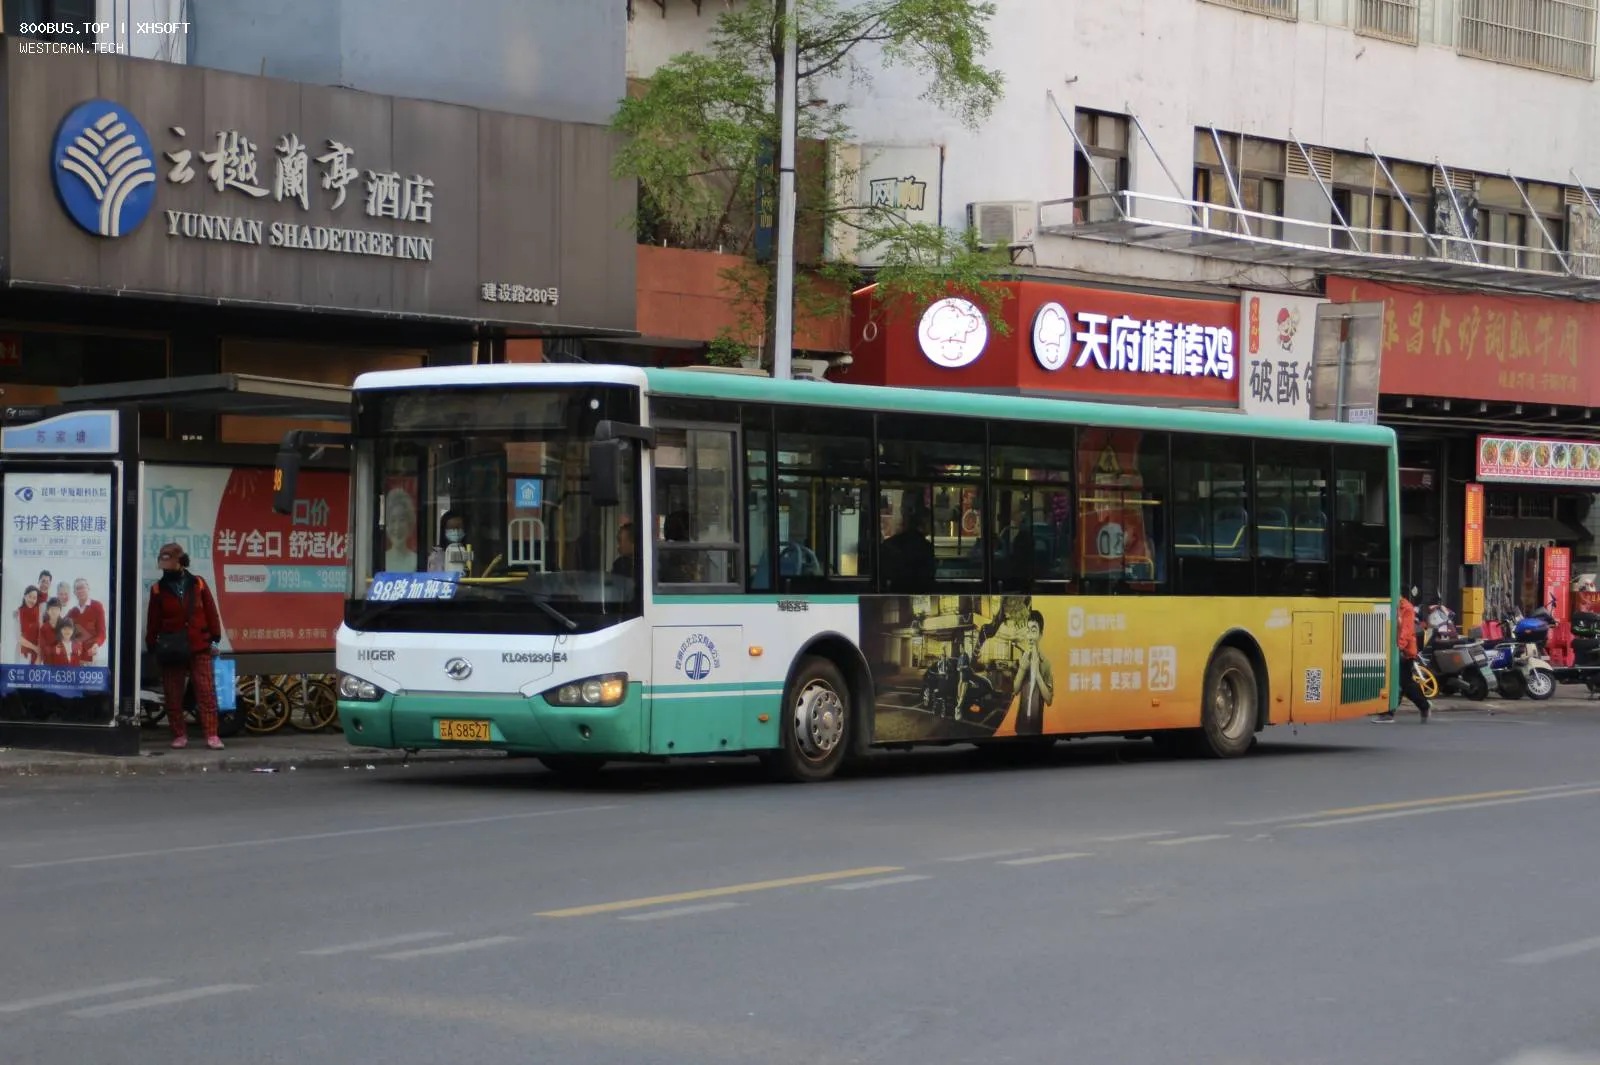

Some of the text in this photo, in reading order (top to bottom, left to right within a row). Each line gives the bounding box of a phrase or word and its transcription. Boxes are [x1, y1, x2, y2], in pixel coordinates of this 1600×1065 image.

[166, 209, 433, 262] YUNNAN SHADETREE INN
[481, 282, 560, 306] 建设路280号
[1075, 312, 1235, 381] 天府棒棒鸡
[13, 514, 108, 533] 守护全家眼健康
[218, 529, 282, 558] 半/全口
[357, 650, 395, 661] HIGER
[79, 671, 104, 684] 9999
[1151, 660, 1170, 687] 25
